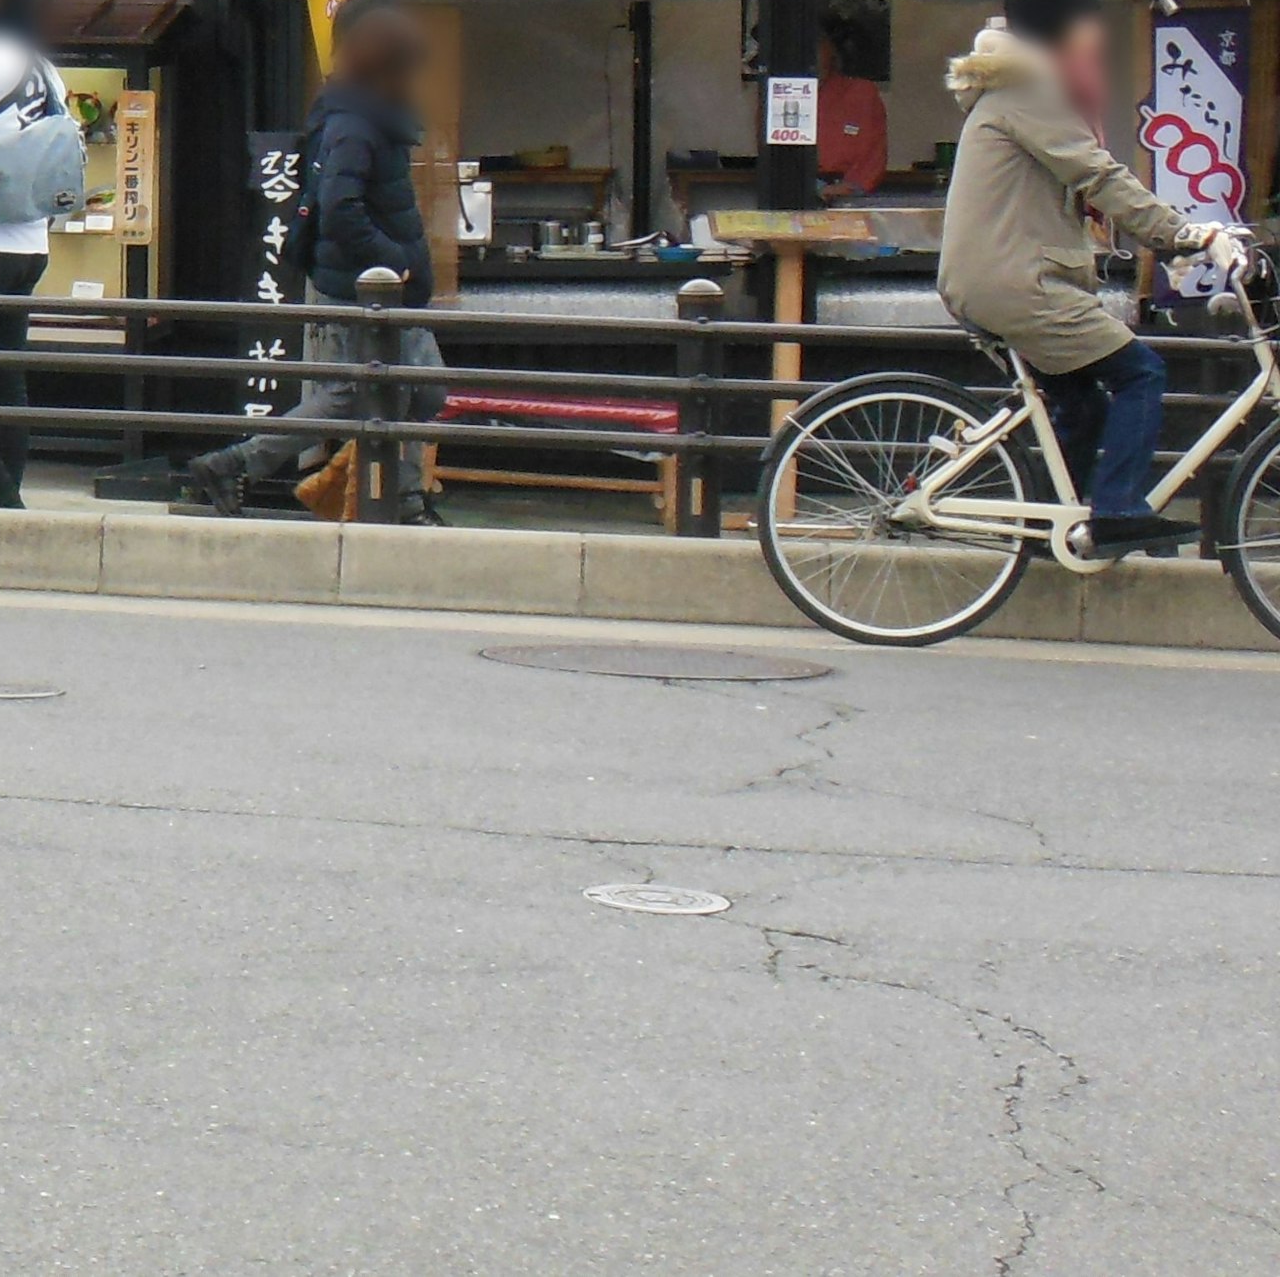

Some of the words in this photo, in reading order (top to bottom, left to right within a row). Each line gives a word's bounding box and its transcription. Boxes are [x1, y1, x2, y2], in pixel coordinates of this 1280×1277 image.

[1218, 29, 1237, 66] 京都
[124, 122, 140, 221] キリン一番搾り
